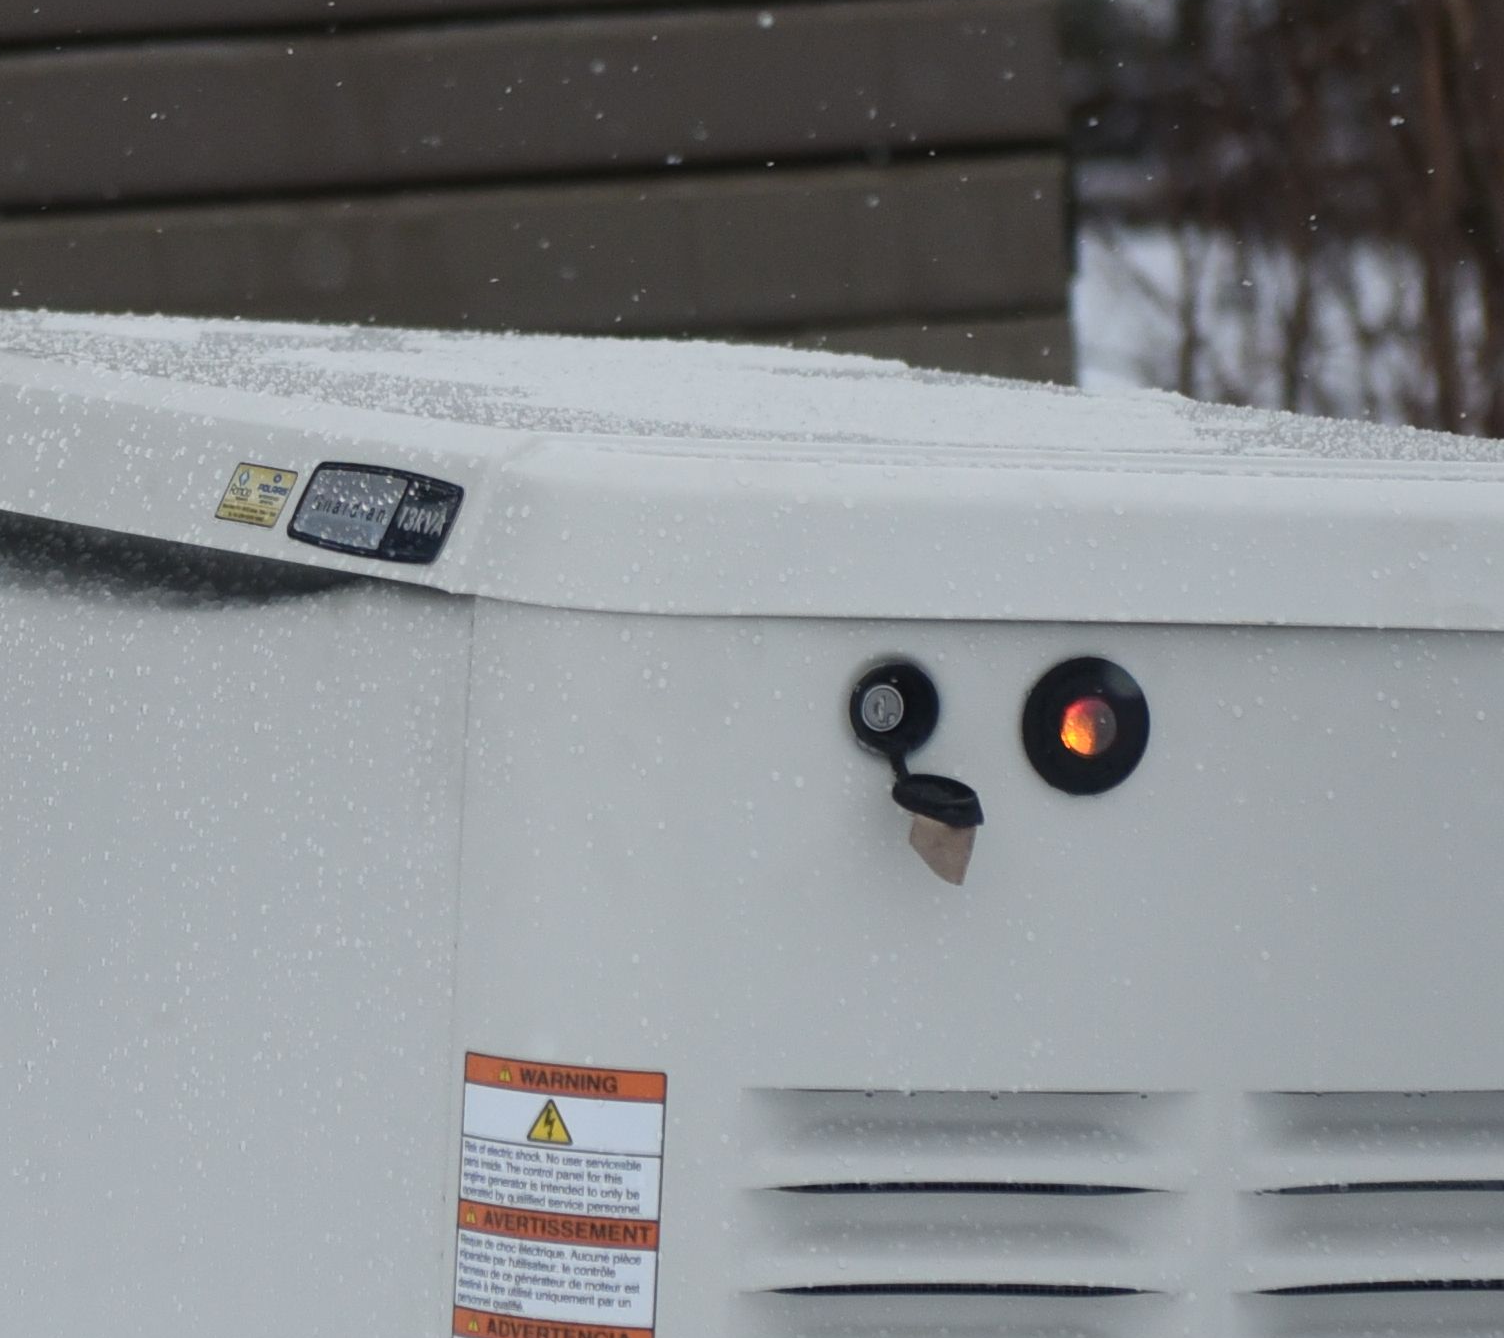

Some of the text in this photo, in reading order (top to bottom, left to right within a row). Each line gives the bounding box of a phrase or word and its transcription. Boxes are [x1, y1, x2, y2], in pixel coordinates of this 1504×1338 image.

[520, 1068, 618, 1094] WARNING
[546, 1152, 559, 1164] No
[562, 1156, 582, 1166] user
[586, 1156, 642, 1170] serviceable
[506, 1163, 623, 1184] The control panel for this
[495, 1190, 504, 1203] by
[549, 1196, 584, 1210] service
[530, 1180, 538, 1191] is
[541, 1181, 584, 1196] intended
[587, 1186, 597, 1197] to
[600, 1187, 623, 1202] only
[626, 1189, 640, 1200] be
[483, 1210, 652, 1244] AVERTISSEMENT
[571, 1249, 609, 1262] Aucune
[569, 1278, 581, 1289] de
[585, 1280, 621, 1293] moteur
[625, 1283, 640, 1294] est
[536, 1289, 594, 1308] uniquement
[598, 1298, 614, 1310] par
[619, 1300, 632, 1308] un
